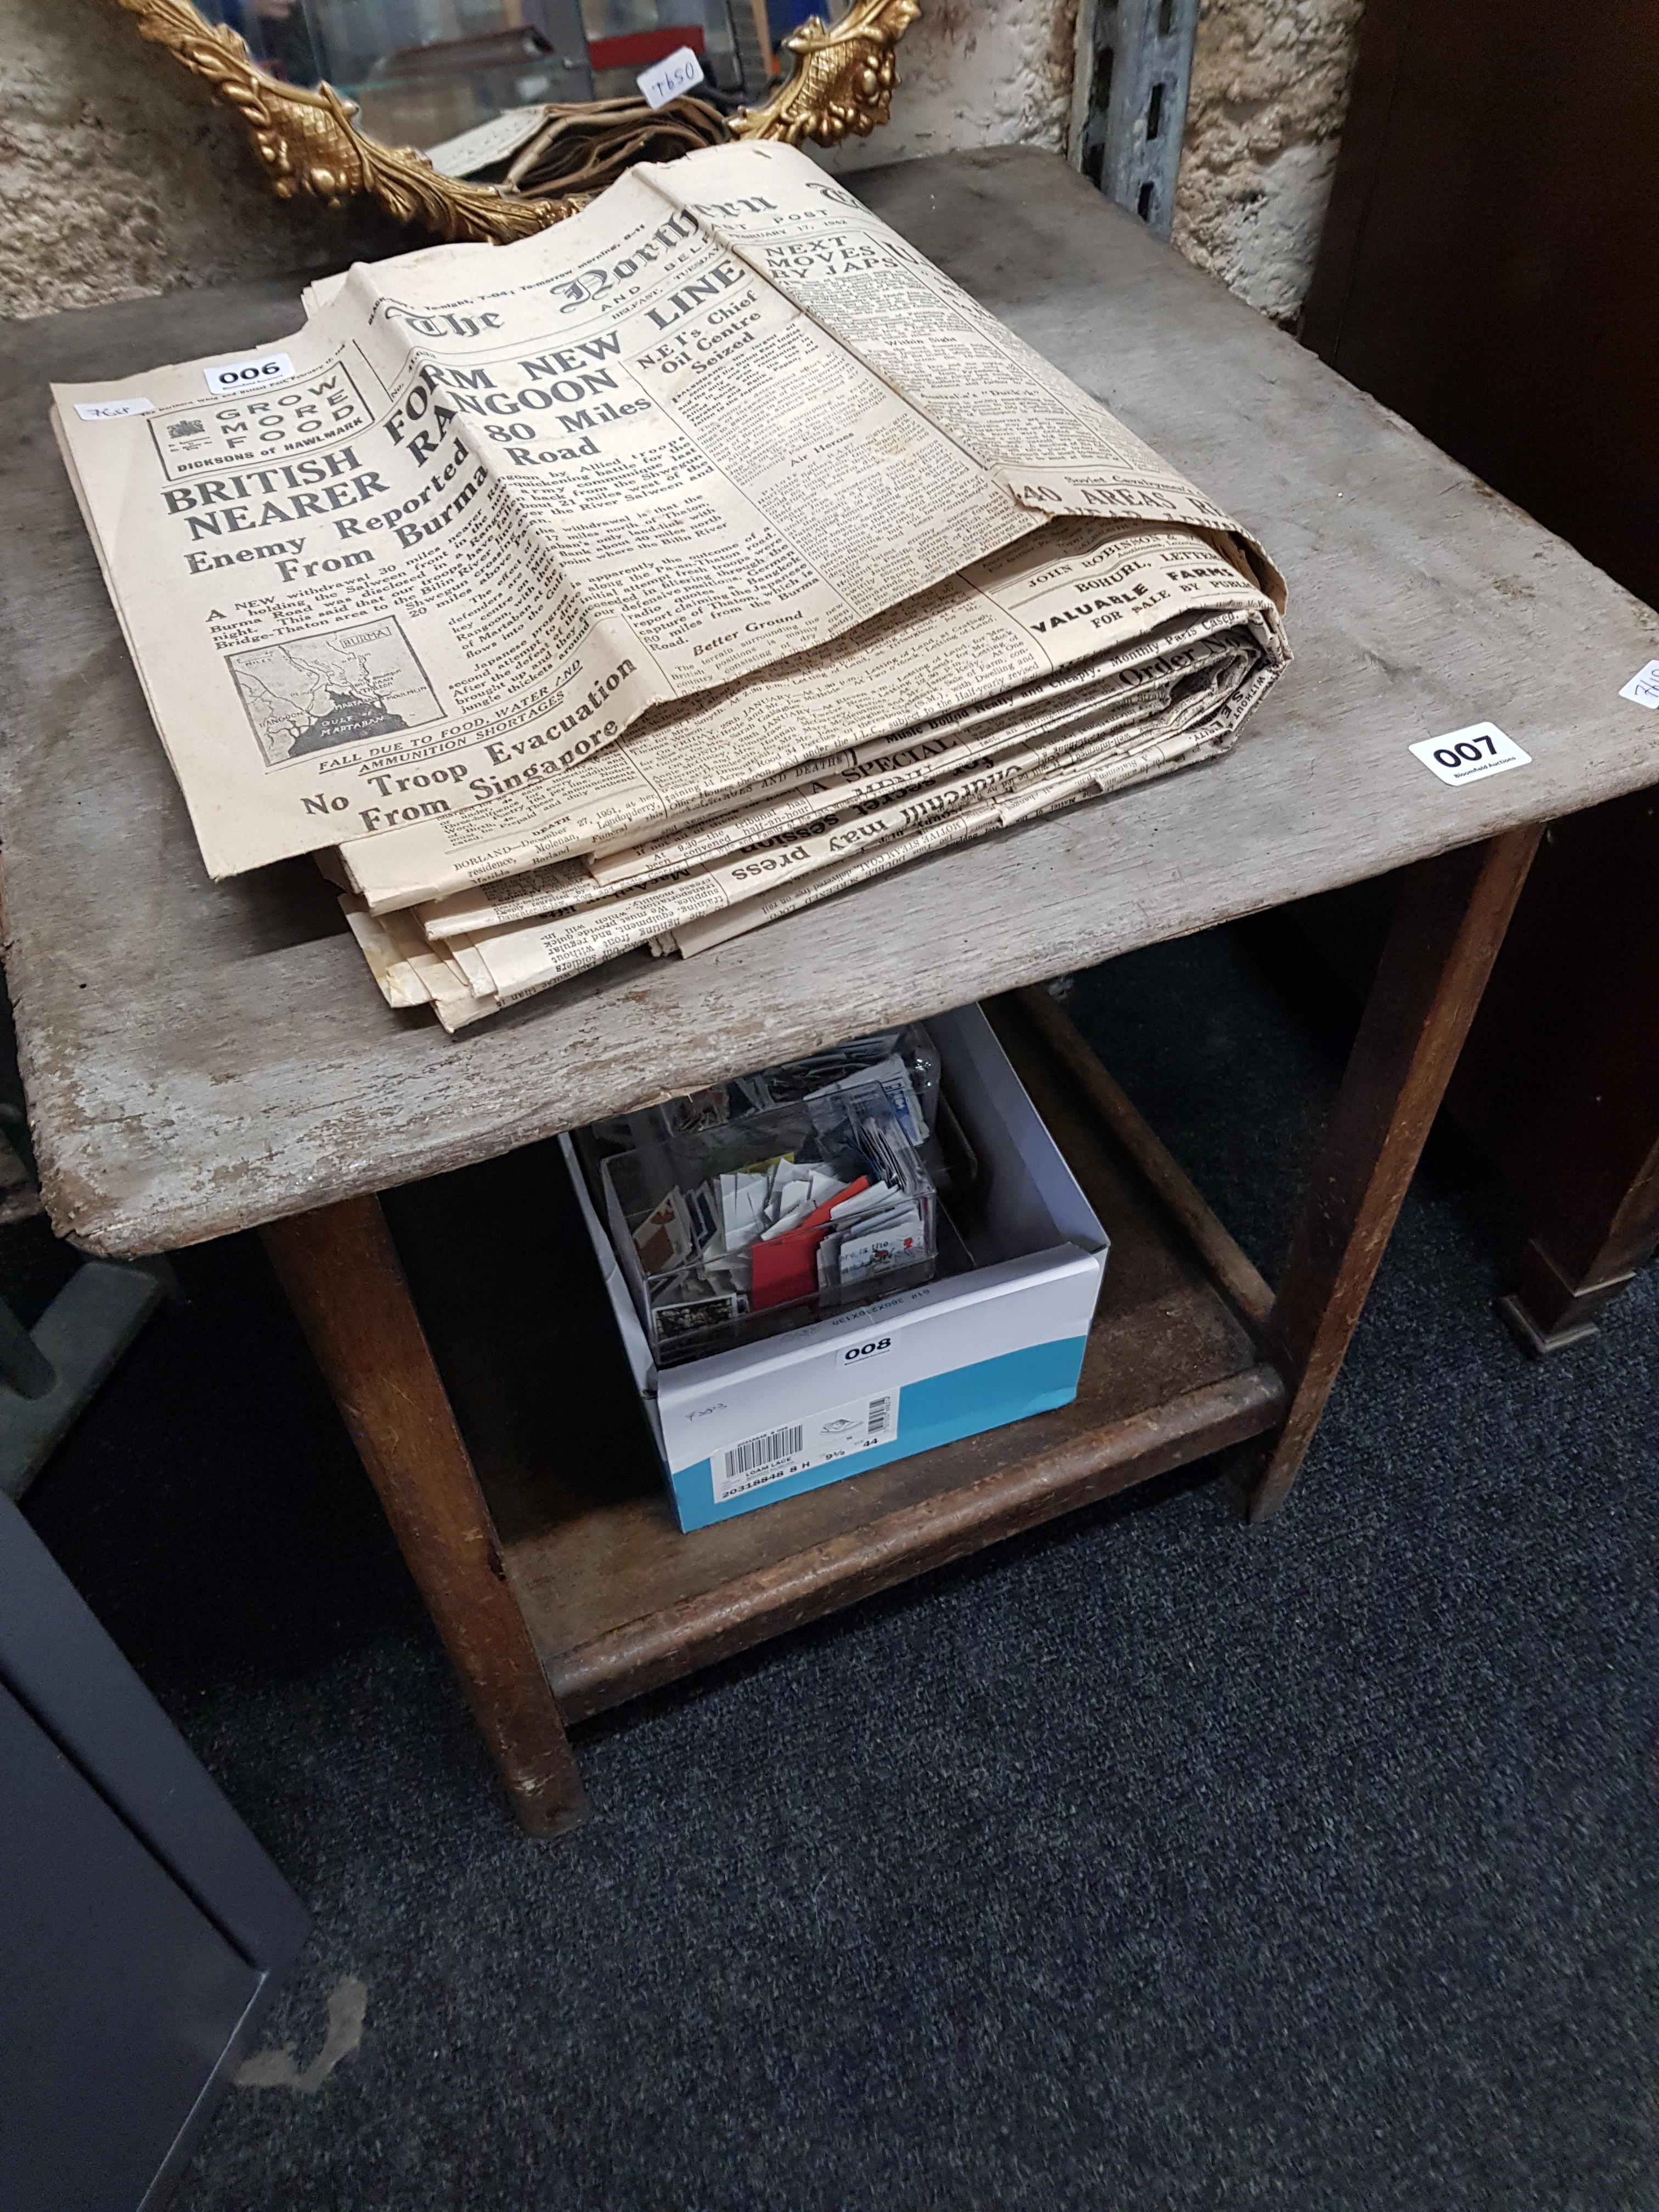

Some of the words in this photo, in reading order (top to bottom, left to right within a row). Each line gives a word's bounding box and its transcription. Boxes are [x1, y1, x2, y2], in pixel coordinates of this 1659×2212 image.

[385, 307, 505, 337] The
[550, 195, 777, 313] Northern
[520, 269, 572, 290] To-morrow
[578, 243, 620, 268] morning,
[601, 286, 640, 312] AND
[774, 210, 828, 224] POST
[764, 235, 848, 257] NEXT
[766, 245, 876, 268] MOVES
[612, 289, 663, 320] BELFAST,
[729, 229, 787, 239] FEBRUARY
[770, 268, 809, 279] BY
[826, 257, 899, 275] JAPS
[707, 290, 758, 325] Chief
[662, 351, 693, 374] Oil
[696, 312, 761, 352] Centre
[691, 331, 756, 374] Seized
[160, 445, 363, 515] BRITISH
[383, 364, 498, 445] FORM
[517, 330, 621, 381] NEW
[644, 259, 746, 331] LINE
[219, 362, 280, 384] 006
[216, 375, 337, 420] GROW
[221, 389, 348, 434] MORE
[177, 452, 254, 471] DICKSONS
[260, 447, 275, 456] of
[284, 416, 363, 450] HAWLMARK
[226, 405, 354, 448] FOOD
[183, 471, 390, 541] NEARER
[406, 367, 619, 468] RANGOON
[183, 537, 307, 575] Enemy
[332, 437, 469, 539] Reported
[483, 423, 536, 442] 80
[556, 398, 652, 433] Miles
[1081, 488, 1177, 510] AREAS
[206, 609, 227, 623] A
[234, 596, 275, 611] NEW
[286, 573, 370, 599] withdrawal
[379, 565, 396, 575] 30
[405, 546, 440, 566] miles
[448, 509, 483, 544] nearer
[579, 458, 622, 473] Allied
[631, 436, 685, 459] troops
[274, 549, 376, 582] From
[393, 465, 488, 549] Burma
[504, 436, 602, 466] Road
[247, 600, 304, 617] holding
[314, 592, 337, 601] the
[346, 571, 407, 593] Salween
[415, 551, 449, 571] front
[594, 462, 637, 478] battle
[1029, 565, 1073, 588] JOHN
[1081, 534, 1160, 569] ROBINSON
[1075, 561, 1153, 593] BOHURL,
[210, 618, 262, 634] Burma
[273, 605, 313, 619] Road
[324, 597, 352, 607] was
[362, 571, 426, 597] disclosed
[276, 615, 312, 625] This
[318, 605, 349, 617] said
[356, 596, 385, 608] that
[391, 585, 415, 597] our
[1030, 582, 1150, 634] VALUABLE
[1090, 610, 1124, 629] FOR
[1132, 590, 1171, 613] SALE
[1179, 583, 1200, 592] BY
[344, 630, 387, 646] BURMA
[693, 630, 739, 656] Better
[745, 610, 804, 633] Ground
[885, 726, 924, 745] Music
[973, 692, 1014, 714] Neatly
[1020, 684, 1043, 697] and
[1049, 665, 1101, 691] Cheaply.
[1111, 642, 1160, 667] Monthly
[1164, 628, 1198, 646] Parts
[1201, 612, 1239, 631] Cased.
[1118, 641, 1204, 689] Order
[300, 793, 349, 815] No
[368, 761, 469, 797] Troop
[483, 656, 636, 766] Evacuation
[319, 753, 362, 771] FALL
[369, 742, 403, 757] DUE
[410, 735, 433, 747] TO
[441, 718, 490, 738] FOOD,
[495, 686, 549, 718] WATER
[555, 658, 581, 687] AND
[320, 716, 385, 737] MARTABAN
[321, 716, 353, 726] GULF
[359, 737, 467, 773] AMMUNITION
[476, 691, 565, 740] SHORTAGES
[809, 781, 829, 795] A
[842, 736, 959, 786] SPECIAL
[1433, 735, 1497, 768] 007
[1453, 764, 1488, 779] Bloomfield
[1488, 755, 1516, 768] Auctions
[358, 797, 452, 832] From
[469, 716, 619, 800] Singapore
[577, 817, 593, 827] 27,
[596, 808, 622, 819] 1951,
[735, 808, 777, 831] tribunal
[788, 798, 806, 809] has
[852, 780, 936, 816] secret
[467, 857, 517, 878] residence,
[596, 799, 661, 830] Londonderry,
[531, 815, 572, 837] DEATH
[531, 847, 571, 866] Borland
[591, 826, 628, 843] Funeral
[683, 835, 731, 857] convened
[743, 804, 809, 837] half-an-hour
[829, 819, 888, 852] may
[731, 846, 811, 880] press
[543, 934, 574, 948] quick
[577, 919, 616, 937] provide
[592, 930, 612, 943] and
[602, 934, 630, 949] front
[616, 911, 674, 934] equipment,
[639, 918, 680, 936] fighting
[548, 938, 588, 955] regular
[551, 945, 595, 963] without
[844, 1338, 891, 1361] 008
[722, 1471, 784, 1499] 20318848
[862, 1438, 878, 1447] 44
[746, 1466, 769, 1477] LOAM
[771, 1457, 792, 1468] LACE
